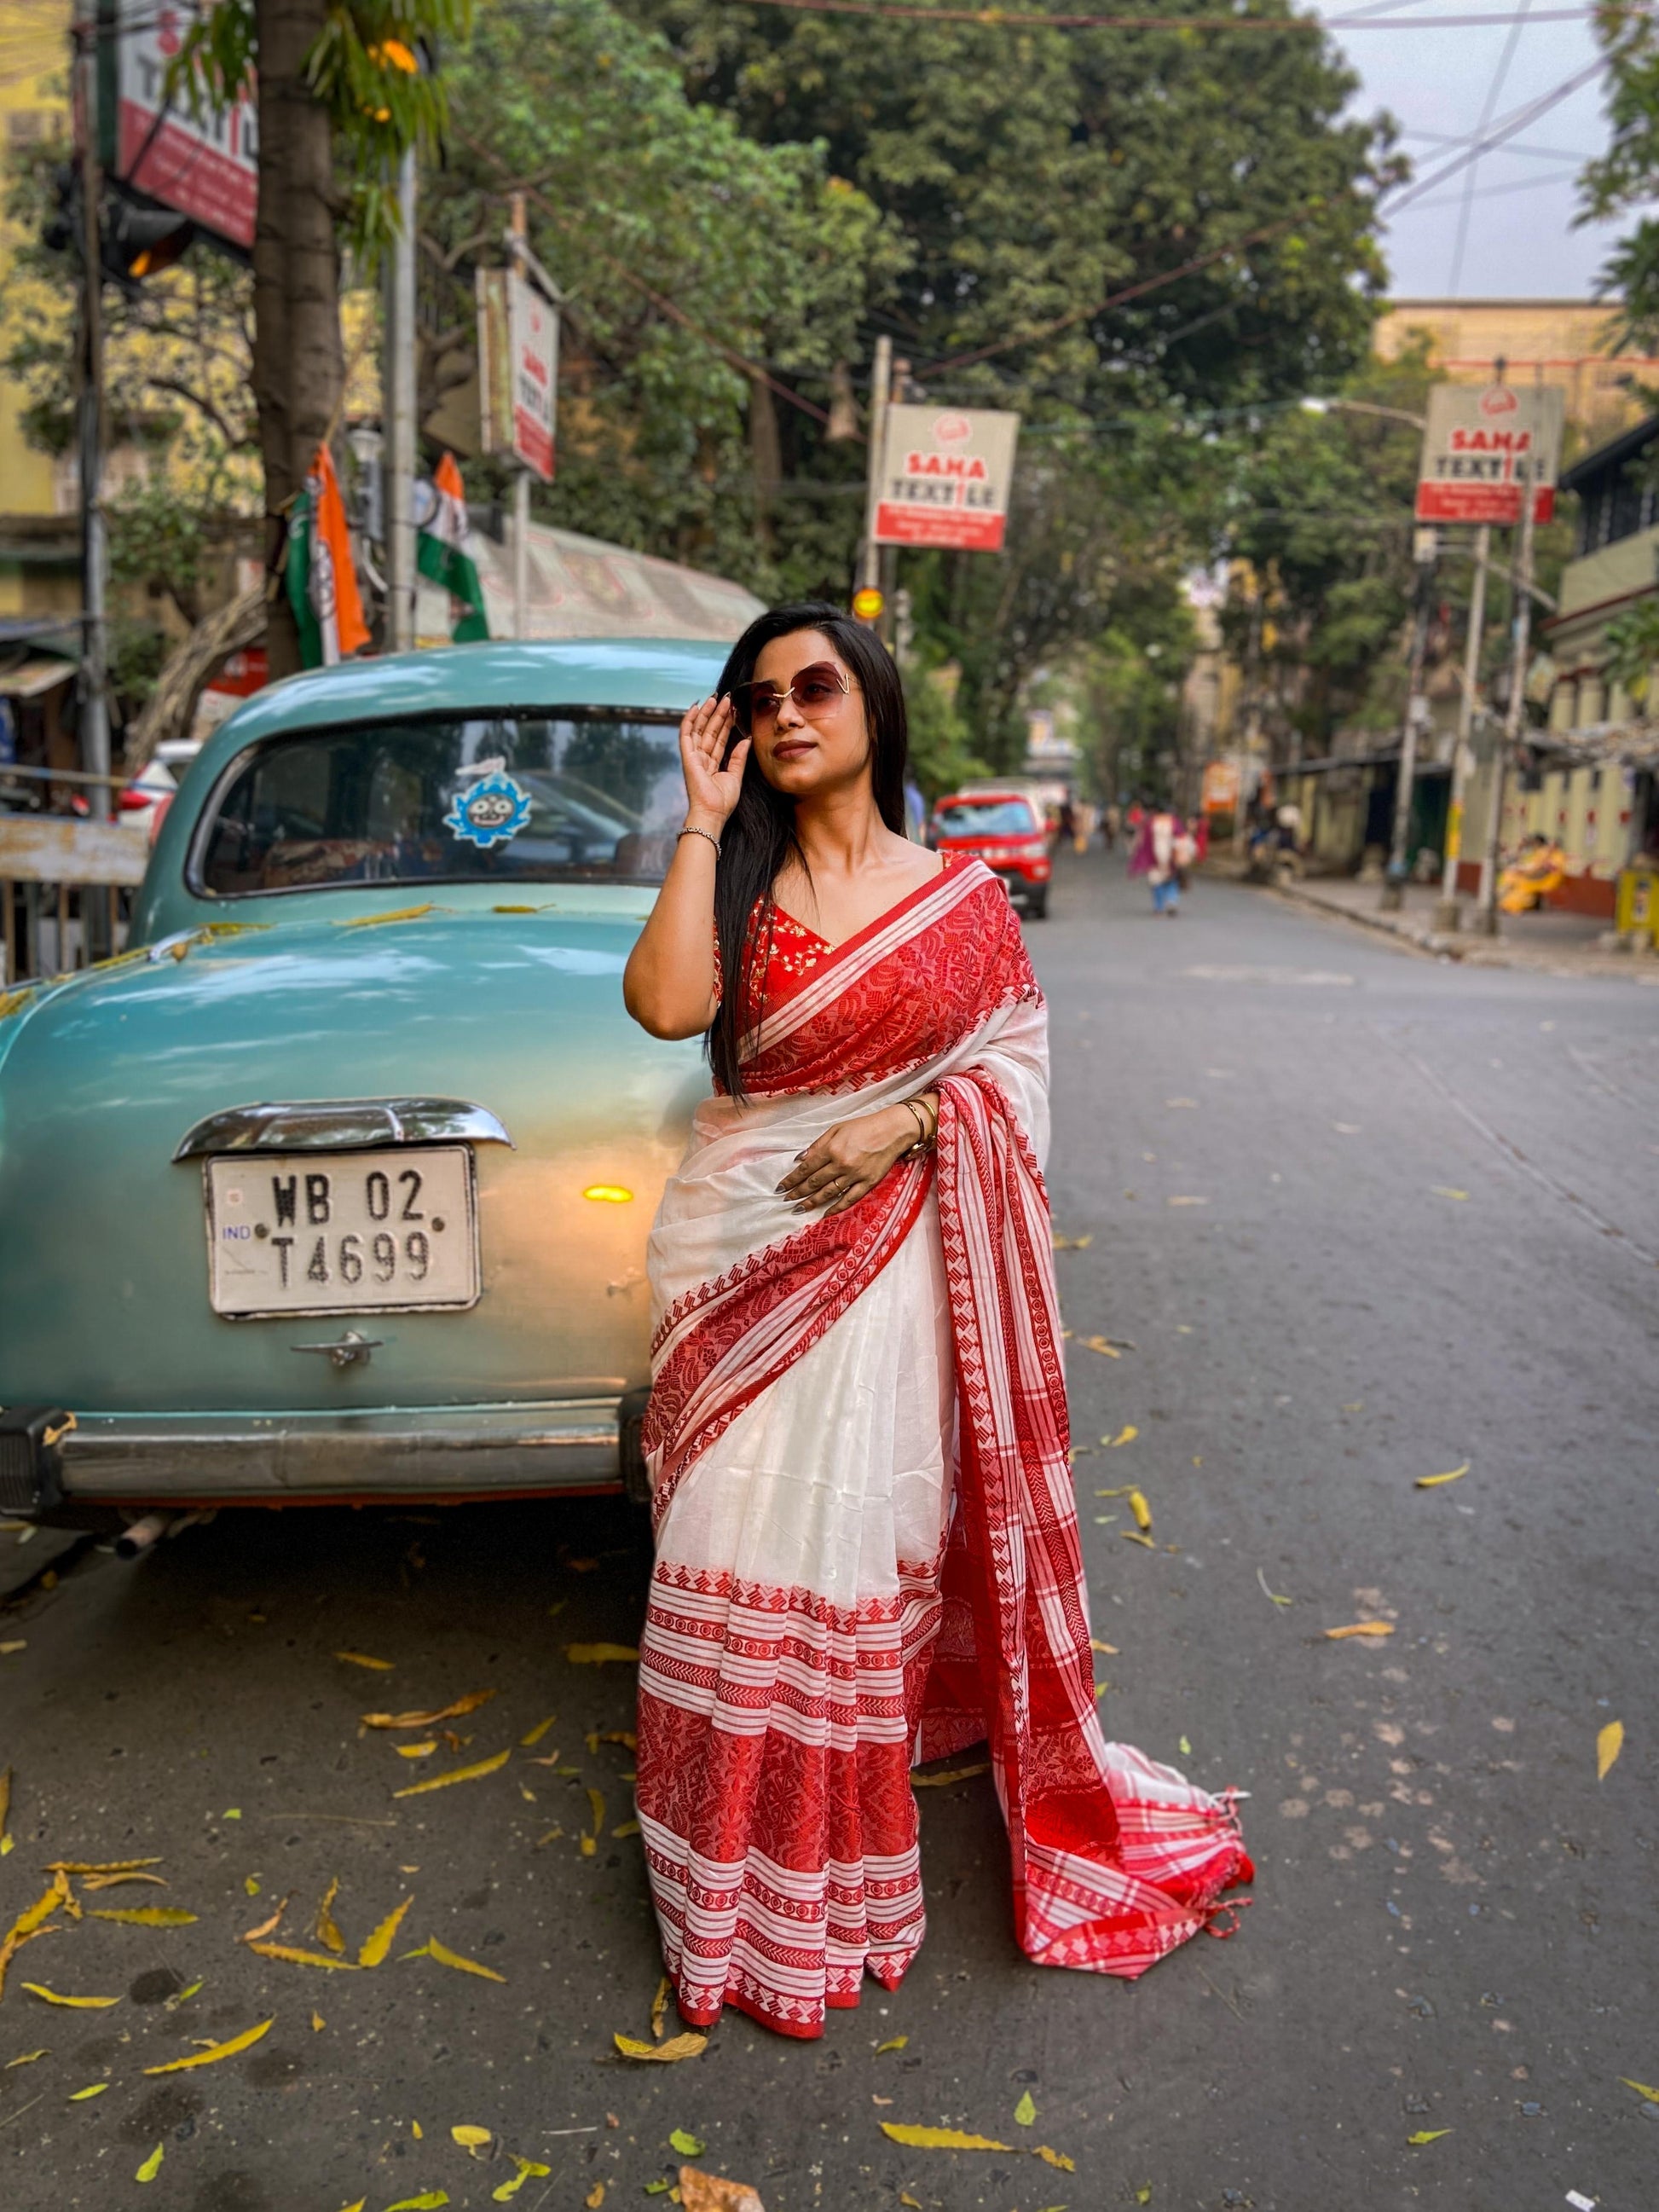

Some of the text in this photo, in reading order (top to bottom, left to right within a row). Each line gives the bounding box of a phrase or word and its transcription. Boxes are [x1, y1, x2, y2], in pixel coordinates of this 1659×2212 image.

[907, 453, 985, 479] SAHA
[271, 1169, 425, 1227] WB 02
[223, 1225, 251, 1240] IND
[270, 1231, 430, 1288] T4699
